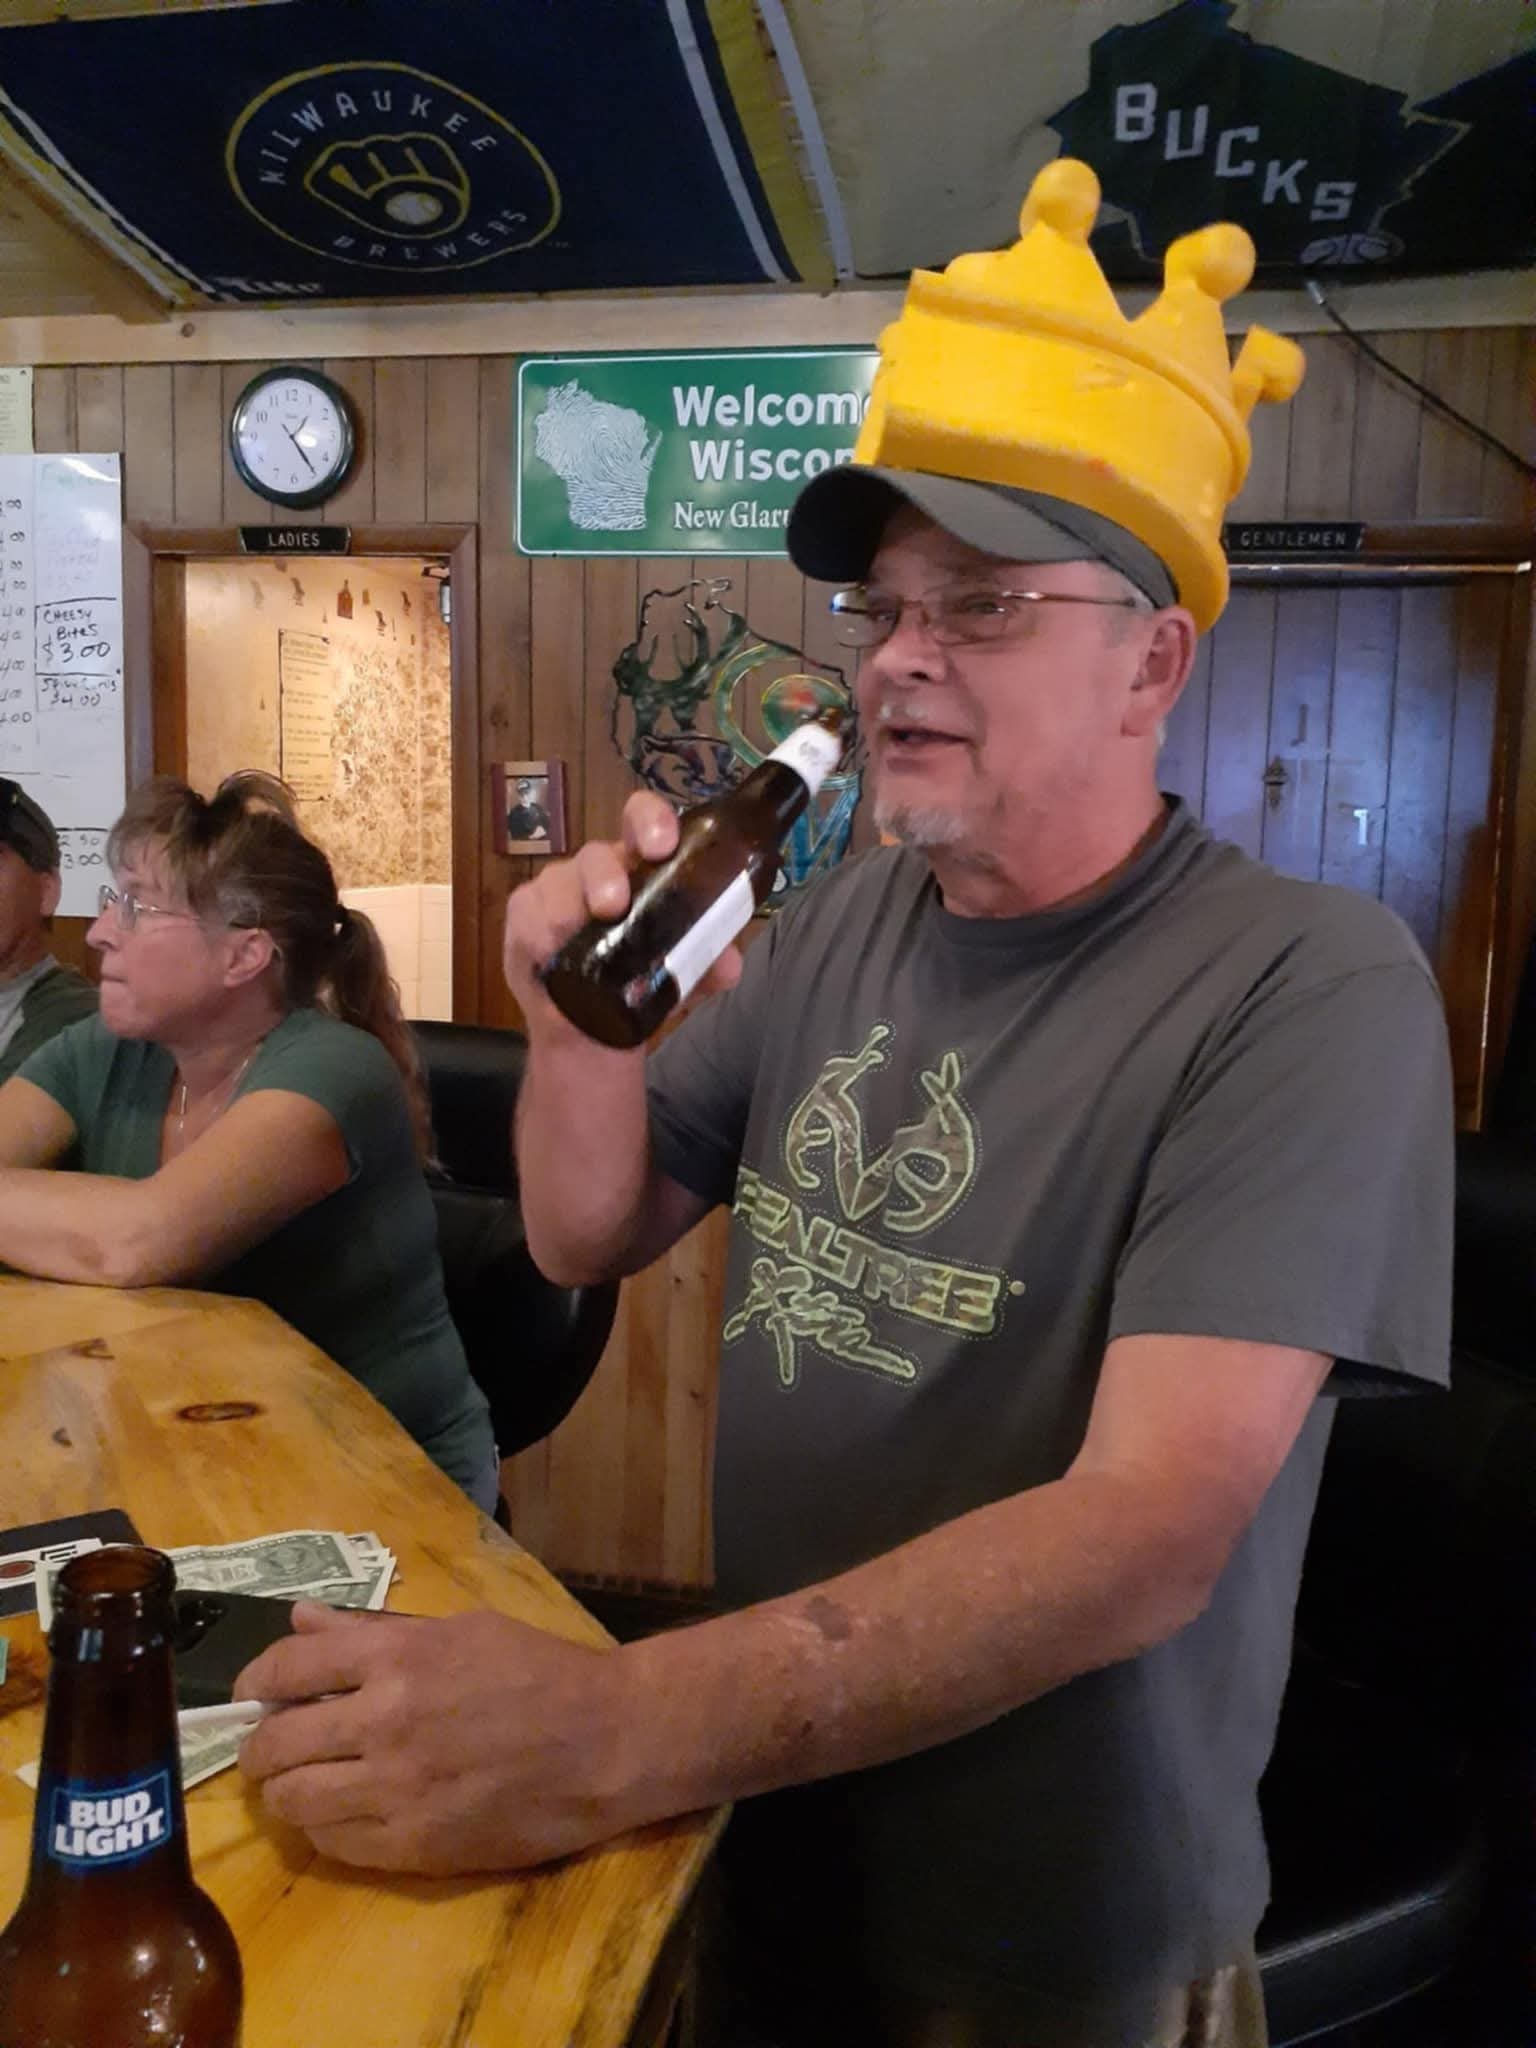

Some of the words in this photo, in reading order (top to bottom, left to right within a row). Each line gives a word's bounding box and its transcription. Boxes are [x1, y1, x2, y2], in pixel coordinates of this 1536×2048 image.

[260, 90, 498, 186] MILWAUKEE
[1114, 82, 1358, 221] BUCKS
[333, 209, 527, 261] BREWERS
[672, 384, 872, 427] Welcom
[673, 501, 726, 529] New
[267, 531, 321, 548] LADIES
[1240, 530, 1346, 547] GENTLEMEN
[55, 1807, 164, 1856] LIGHT
[69, 1791, 151, 1829] BUD
